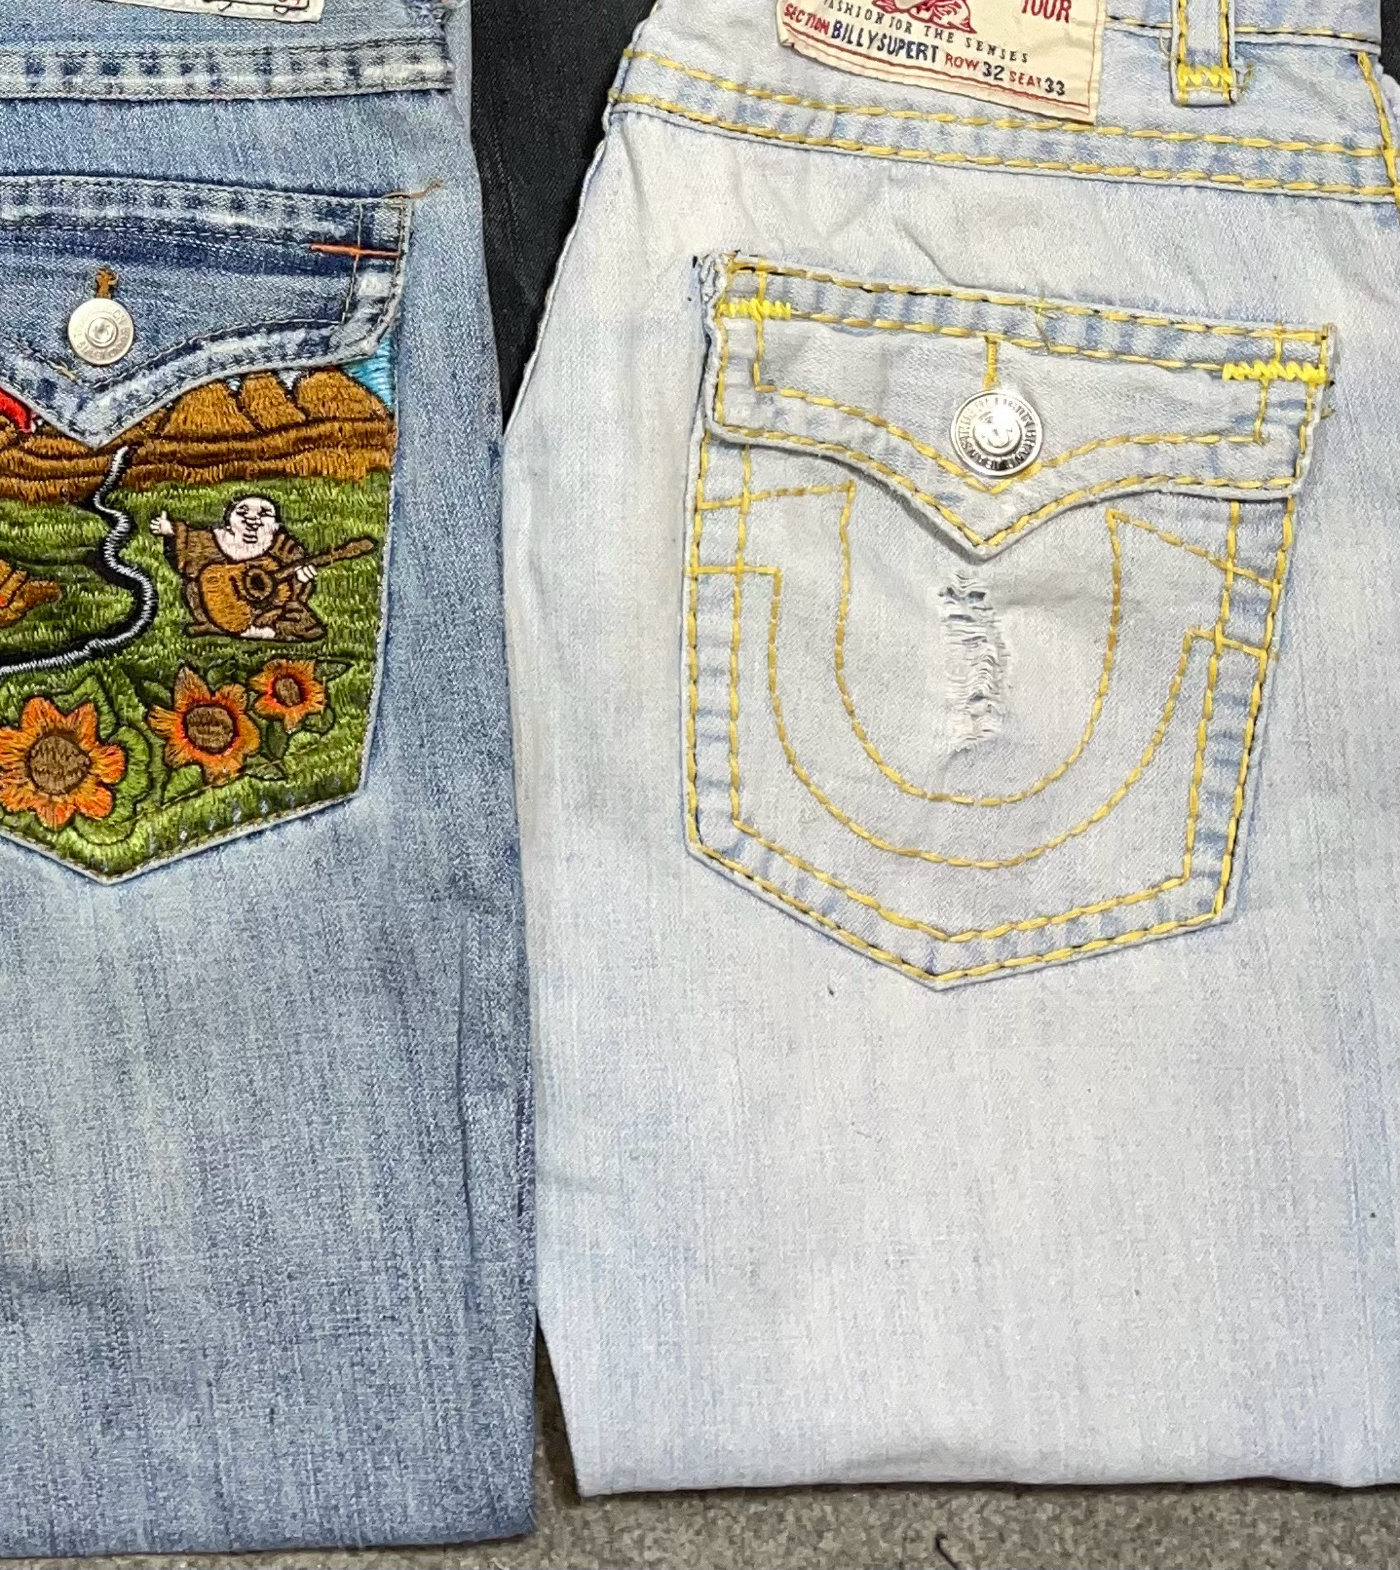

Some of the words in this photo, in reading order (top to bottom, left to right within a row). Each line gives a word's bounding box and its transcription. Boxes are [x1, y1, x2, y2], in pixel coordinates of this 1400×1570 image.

[784, 2, 830, 35] SECTION
[945, 54, 978, 72] ROW
[983, 62, 1005, 81] 32
[1009, 70, 1042, 88] SEAT
[1044, 77, 1067, 96] 33
[888, 17, 912, 34] FOR
[923, 26, 954, 44] THE
[965, 37, 1028, 64] SENSES
